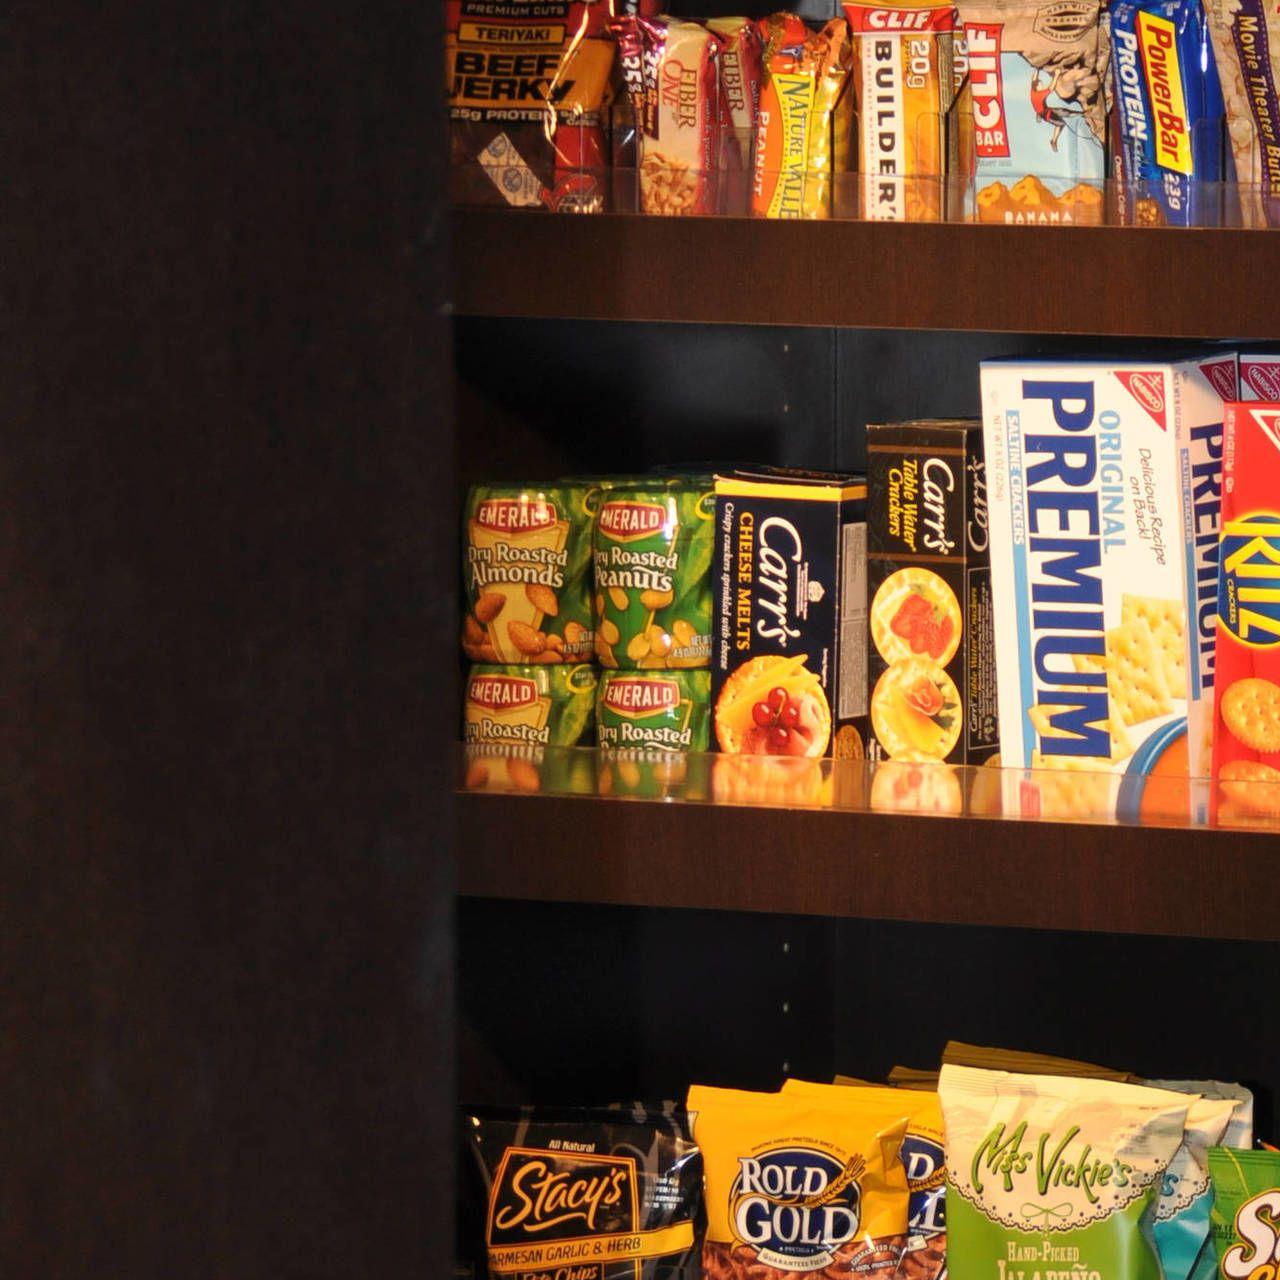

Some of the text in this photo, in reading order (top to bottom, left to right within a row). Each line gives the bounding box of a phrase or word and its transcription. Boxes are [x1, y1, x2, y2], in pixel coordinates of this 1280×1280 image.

[466, 3, 564, 15] PREMIUM CUTS
[868, 10, 931, 29] CLIF
[476, 27, 549, 41] TERIYAKI
[456, 52, 561, 76] BEEF
[662, 59, 683, 107] ONE
[722, 49, 745, 112] FIBER
[906, 40, 931, 90] 20g
[966, 28, 1001, 131] CLIF
[1113, 28, 1149, 142] PROTEIN
[1238, 15, 1259, 70] Movie
[1249, 74, 1273, 146] Theater
[487, 110, 558, 121] PROTEIN
[678, 69, 698, 129] FIBER
[776, 77, 811, 157] NATURE
[1146, 23, 1186, 164] PowerBar
[753, 111, 771, 198] PEANUT
[976, 131, 1005, 147] BAR
[1004, 211, 1074, 225] BANANA
[888, 468, 903, 536] Crackers
[903, 460, 919, 549] Table Water
[1007, 415, 1026, 545] SALTINE CRACKERS
[1099, 410, 1126, 554] ORIGINAL
[479, 505, 551, 528] EMERALD
[721, 502, 735, 533] Crispy
[923, 458, 955, 553] Carr's
[1130, 477, 1151, 541] on Back!
[1139, 447, 1166, 566] Delicious Recipe
[468, 543, 568, 567] Dry Roasted
[471, 563, 564, 588] Almonds
[611, 547, 679, 570] Roasted
[1022, 379, 1111, 759] PREMIUM
[736, 511, 754, 651] CHEESE MELTS
[757, 516, 802, 648] Carr's
[471, 682, 531, 704] EMERALD
[606, 685, 674, 707] EMERALD
[483, 721, 549, 743] Roasted
[622, 723, 692, 745] Roasted
[549, 1139, 595, 1153] All Natural
[970, 1120, 1133, 1203] Miss Vickie's
[496, 1161, 627, 1232] Stacy's
[737, 1157, 829, 1199] ROLD
[736, 1196, 859, 1245] GOLD
[489, 1237, 641, 1267] ARMESAN GARLIC & HERB
[1007, 1241, 1080, 1262] HAND-PICKED
